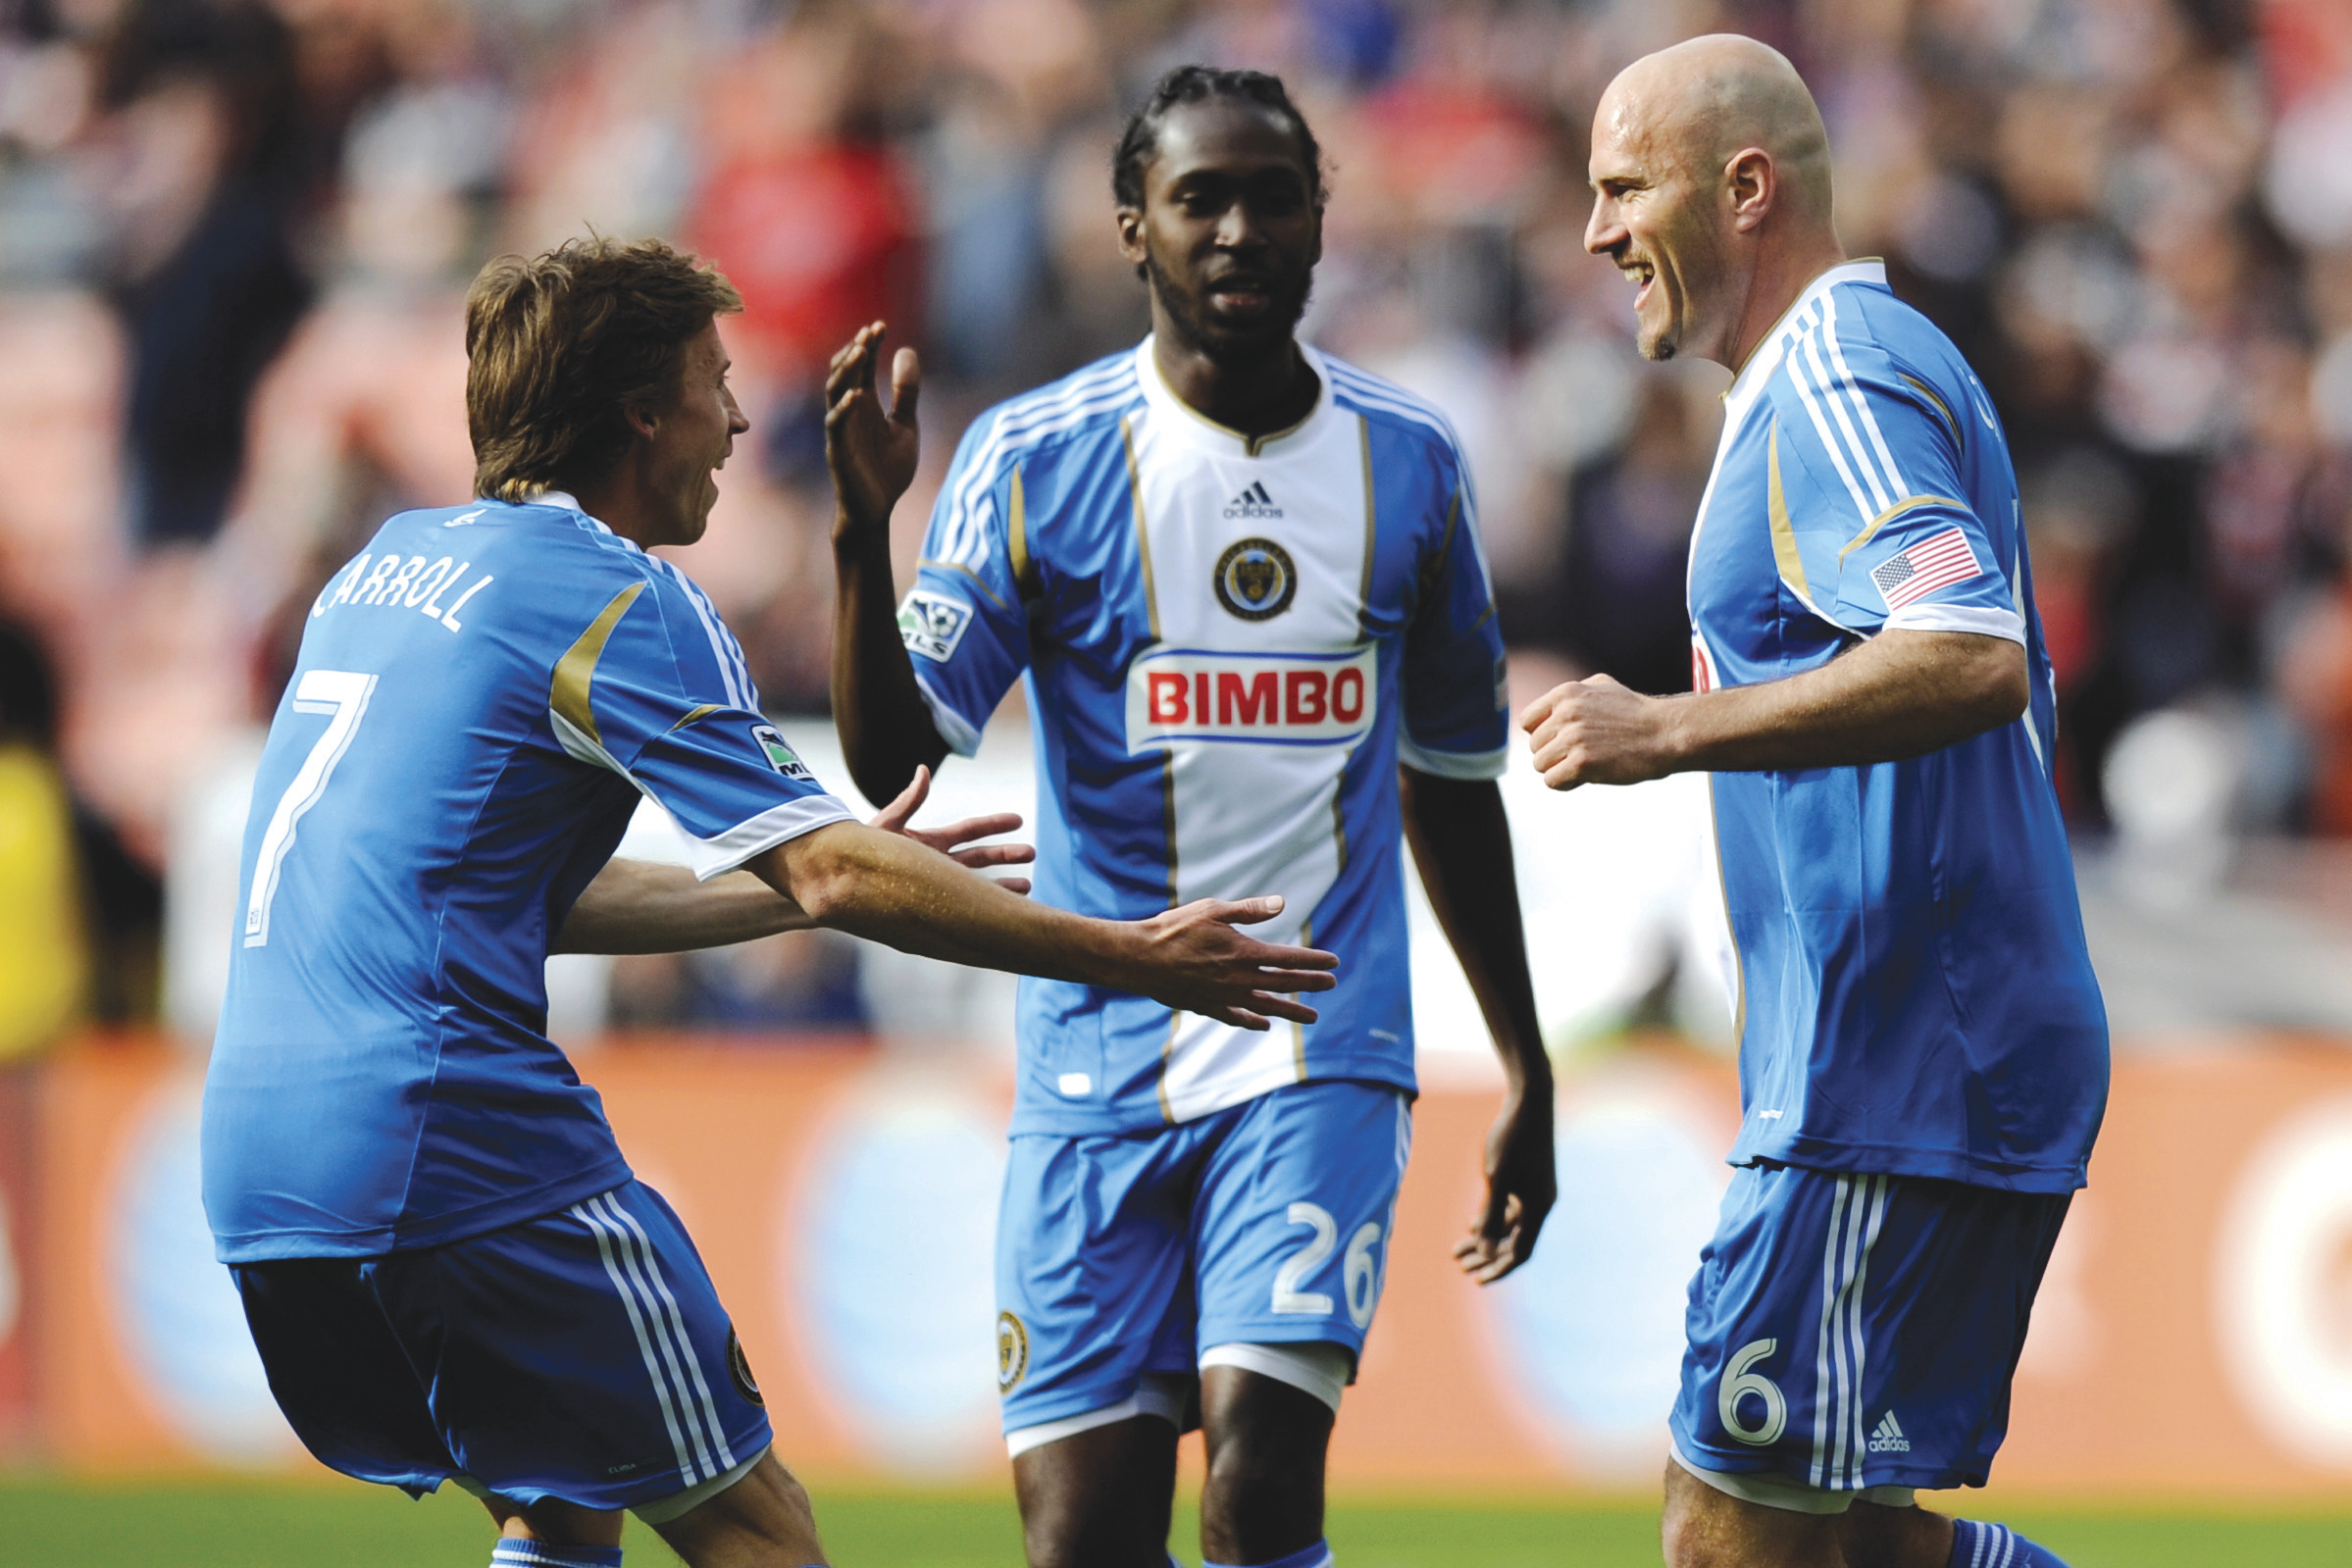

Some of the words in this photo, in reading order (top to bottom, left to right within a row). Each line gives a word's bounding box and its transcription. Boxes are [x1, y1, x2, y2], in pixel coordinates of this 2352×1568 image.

[1223, 506, 1283, 518] adidas
[313, 553, 494, 633] CARROLL
[1148, 667, 1364, 725] BIMBO
[779, 762, 810, 777] M
[243, 670, 380, 948] 7
[1271, 1201, 1381, 1330] 26
[1718, 1338, 1787, 1446] 6
[1868, 1439, 1910, 1452] adidas
